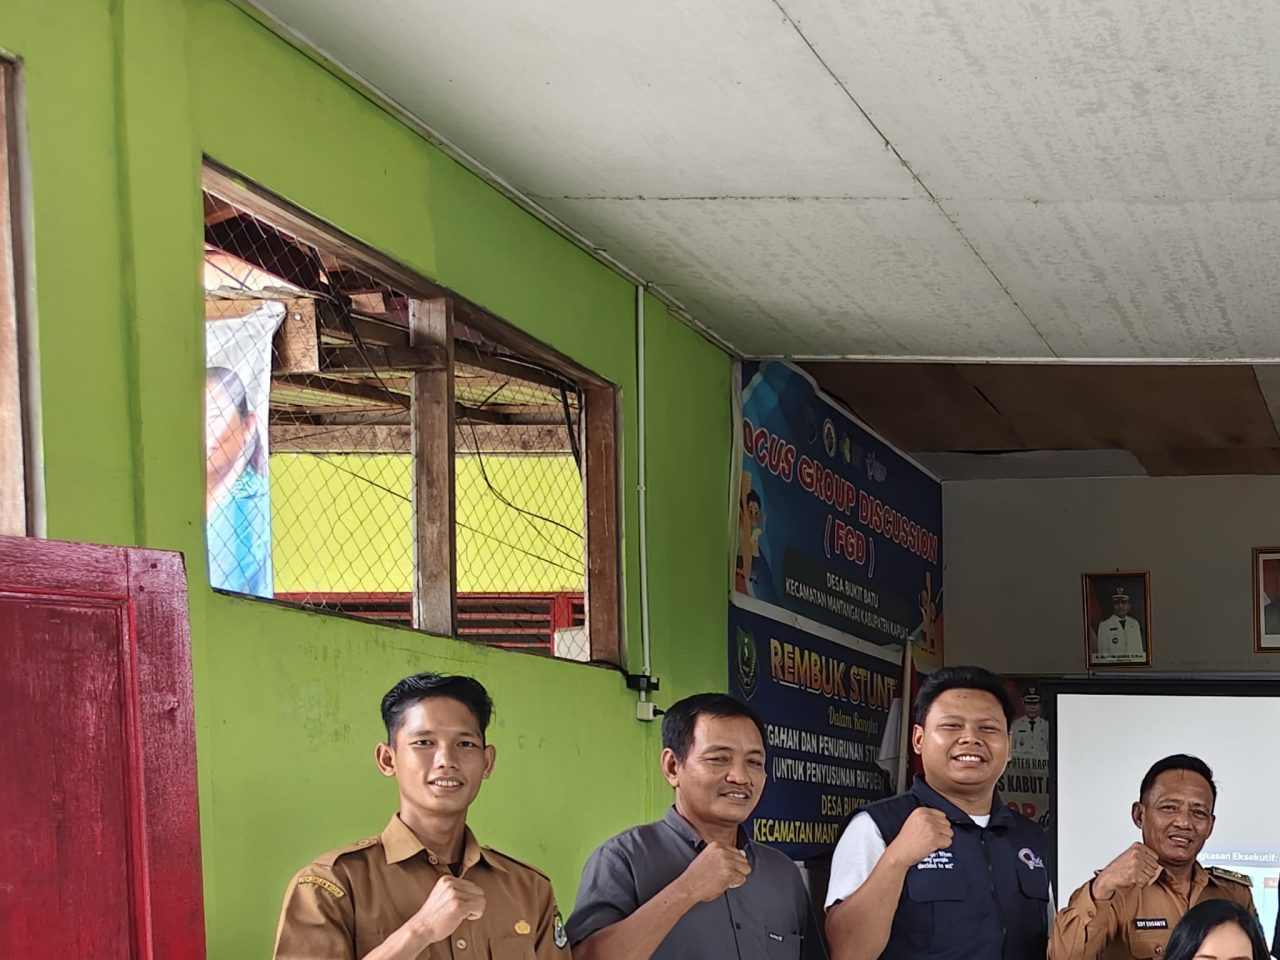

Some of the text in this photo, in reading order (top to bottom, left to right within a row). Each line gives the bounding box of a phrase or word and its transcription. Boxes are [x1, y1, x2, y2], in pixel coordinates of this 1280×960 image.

[743, 417, 939, 565] OCUS GROUP DISCUSSION
[785, 576, 827, 609] KECAMATAN
[860, 609, 890, 635] KABUPATEN
[826, 571, 880, 609] DESA BUKIT BATU
[770, 637, 897, 712] REMBUK STUNT
[828, 705, 853, 729] Dalam
[765, 724, 881, 763] GAHAN DAN PENURUNAN STU
[772, 757, 805, 783] (UNTUK
[805, 761, 855, 788] PENYUSUNAN
[1007, 775, 1043, 793] KABUT
[821, 794, 843, 816] DESA
[753, 818, 839, 844] KECAMATAN MANT
[1232, 847, 1278, 858] Eksekutif:
